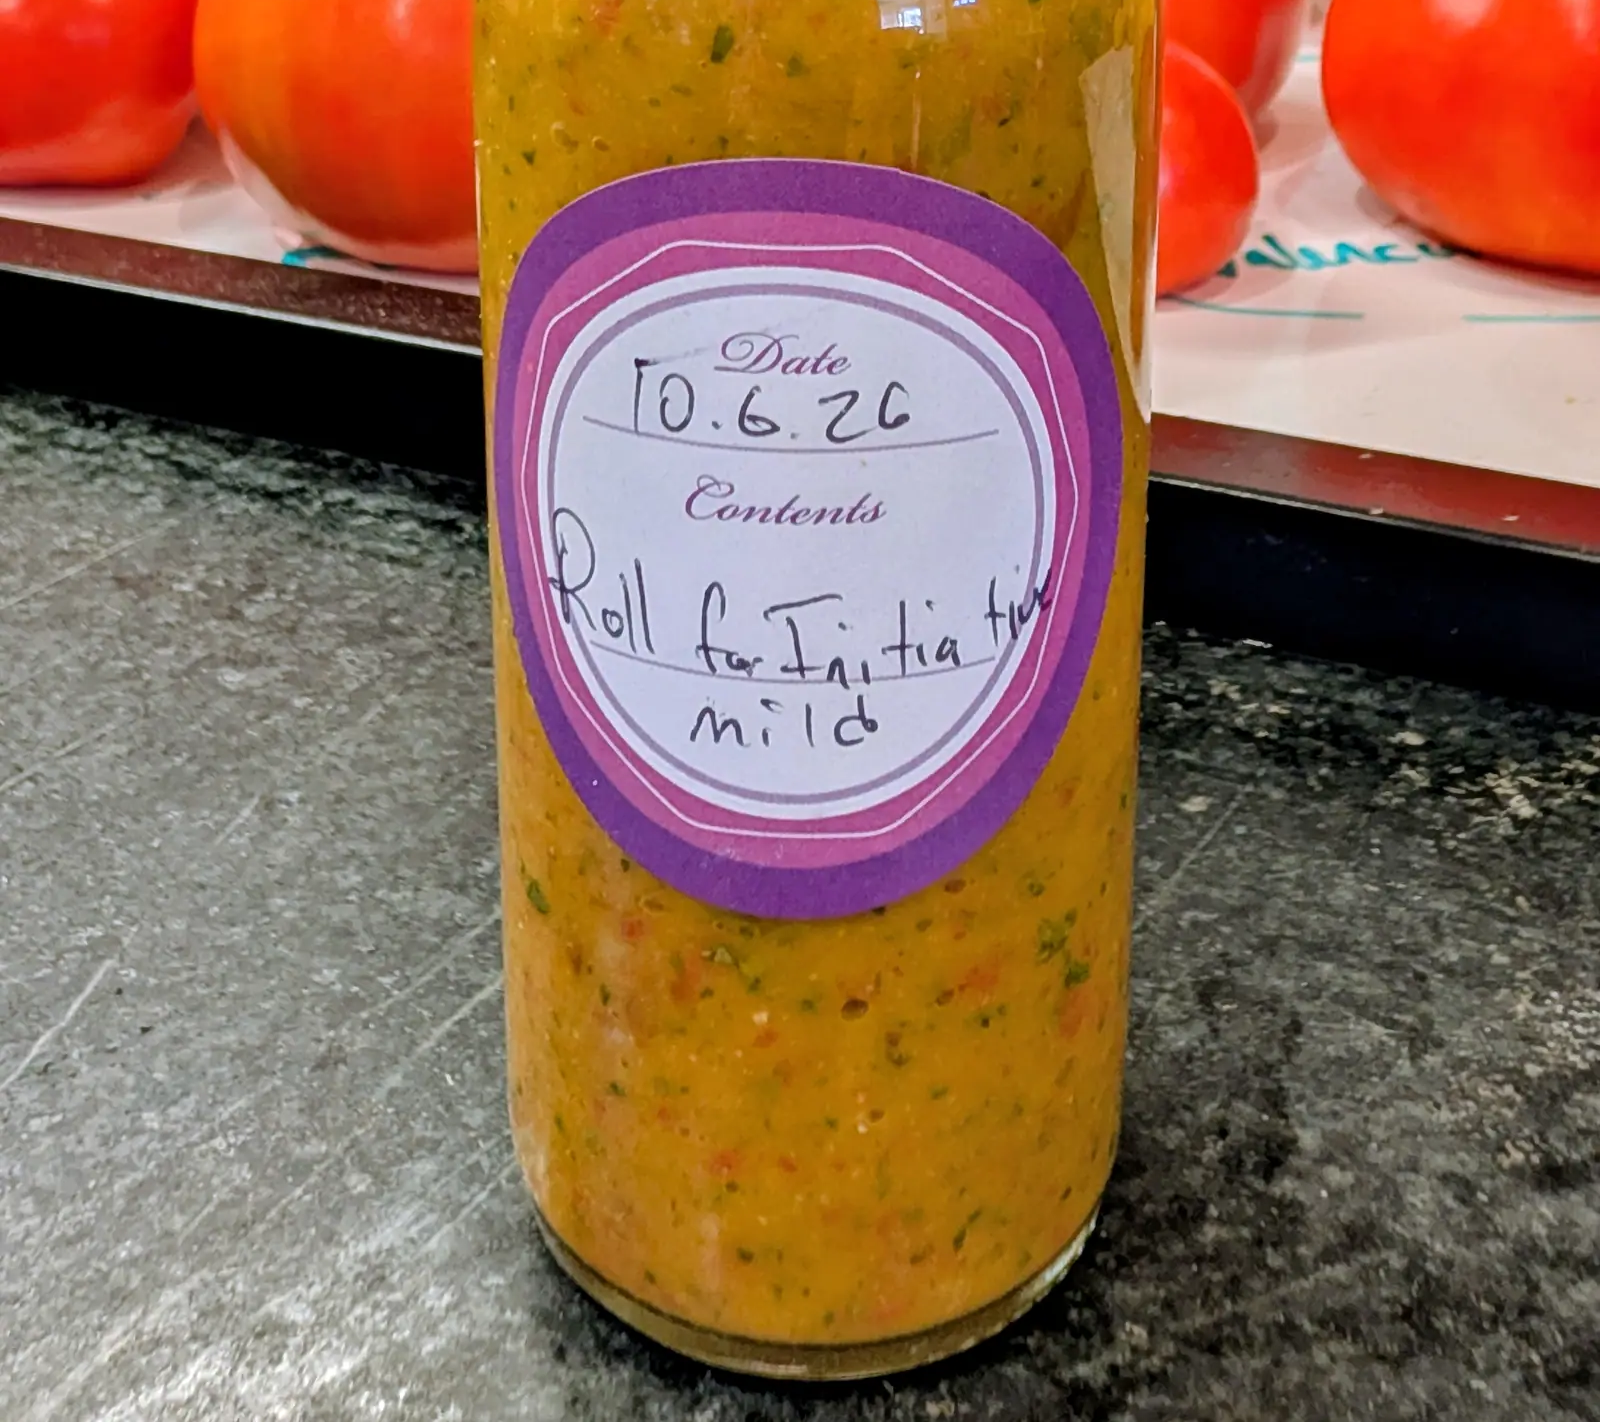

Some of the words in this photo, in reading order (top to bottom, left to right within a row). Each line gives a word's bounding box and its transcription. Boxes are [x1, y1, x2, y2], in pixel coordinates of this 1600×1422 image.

[713, 331, 852, 376] Date
[684, 474, 887, 526] Contents
[549, 507, 655, 654] Roll
[695, 582, 763, 676] for
[690, 694, 879, 747] mild
